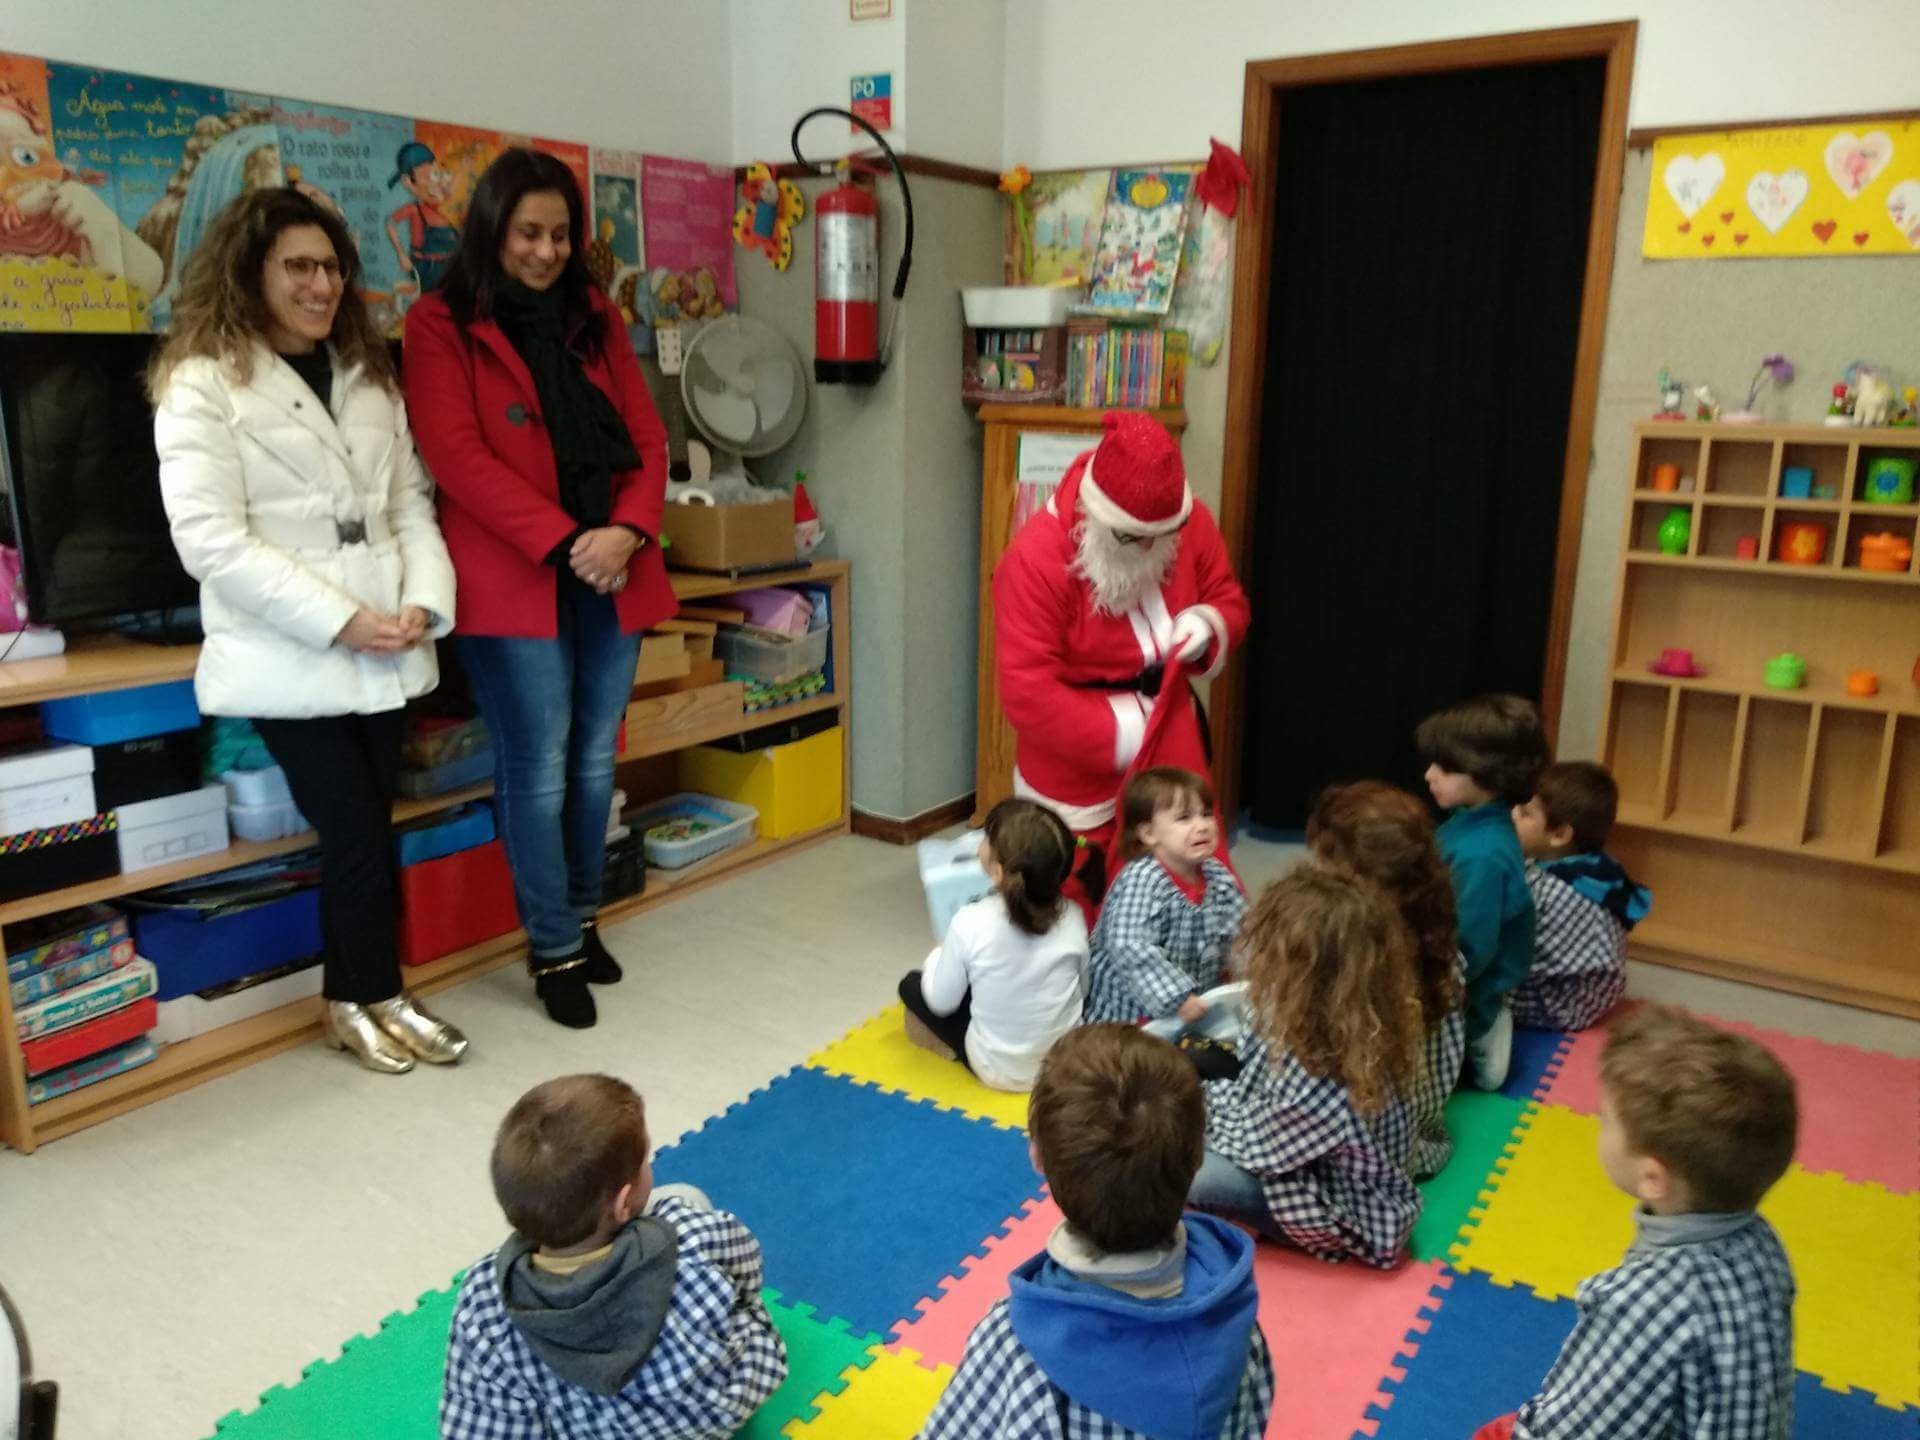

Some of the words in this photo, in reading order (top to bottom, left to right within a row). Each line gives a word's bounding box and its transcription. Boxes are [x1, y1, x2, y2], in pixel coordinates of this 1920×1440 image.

[282, 134, 296, 156] O
[299, 137, 329, 157] rato
[331, 142, 360, 159] roeu
[317, 160, 352, 180] rolha
[354, 163, 371, 180] da
